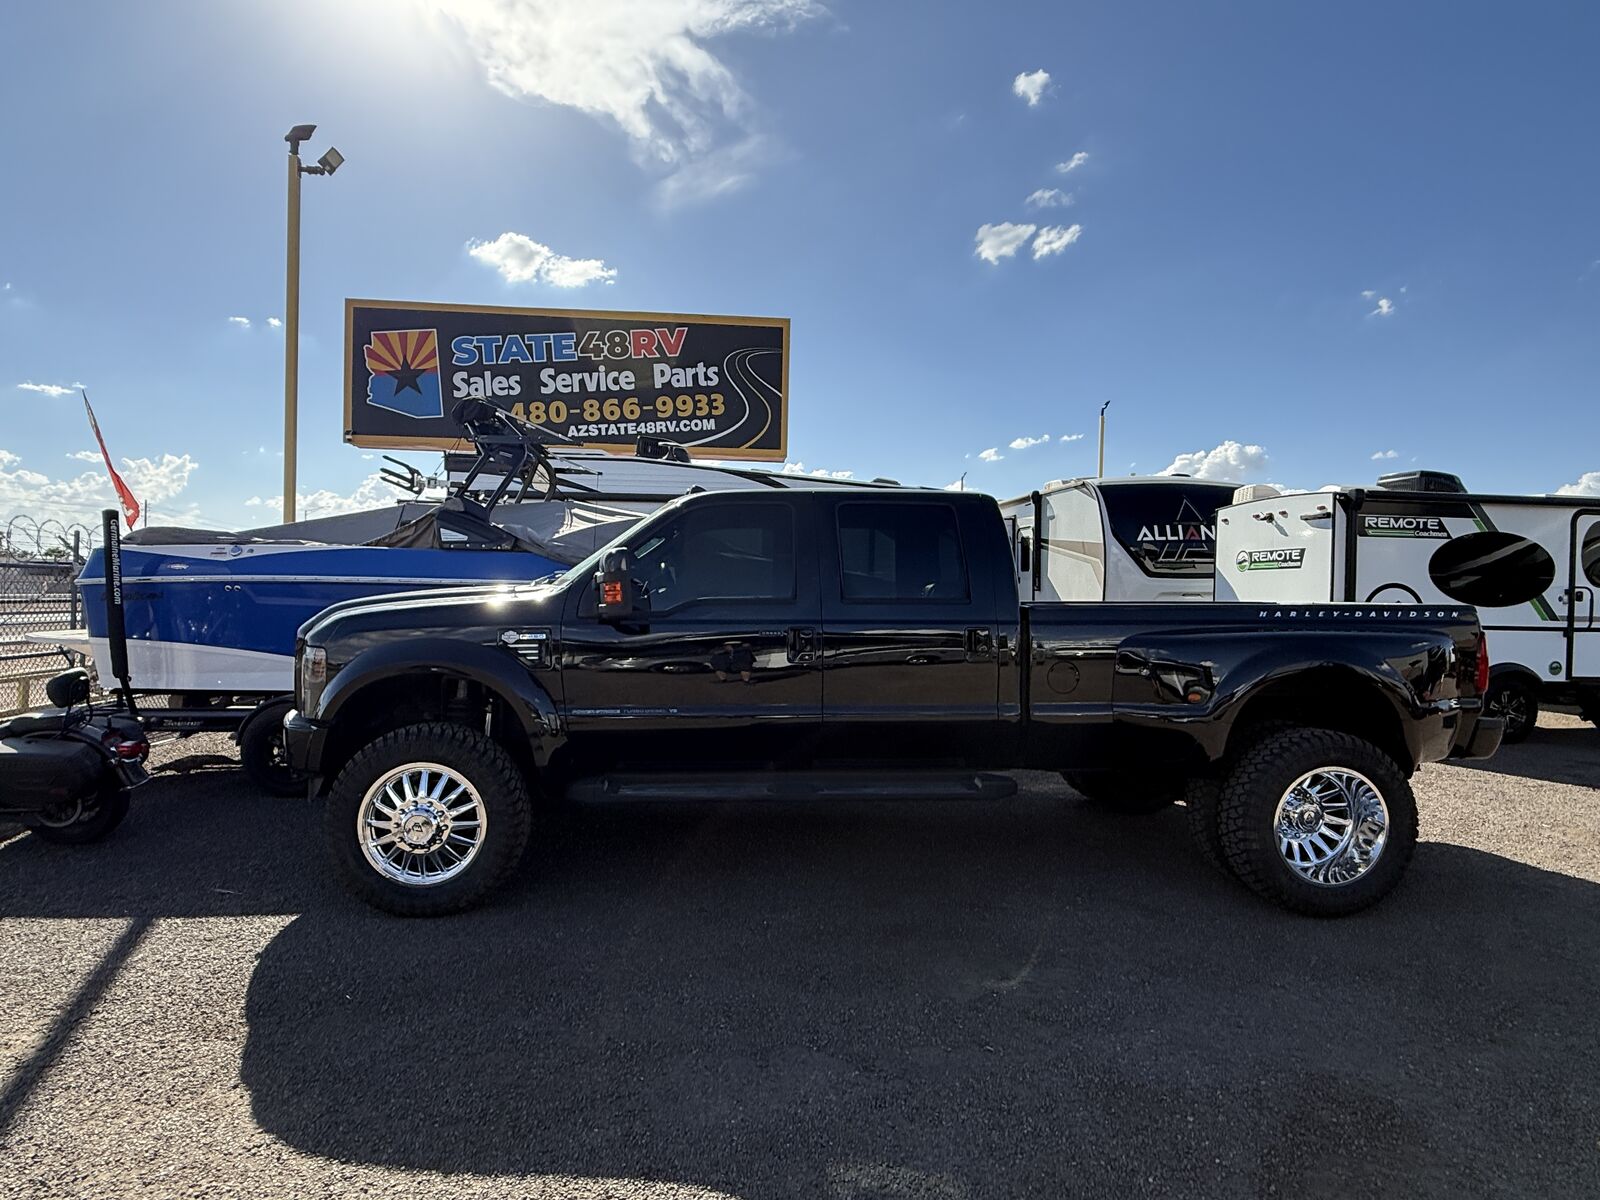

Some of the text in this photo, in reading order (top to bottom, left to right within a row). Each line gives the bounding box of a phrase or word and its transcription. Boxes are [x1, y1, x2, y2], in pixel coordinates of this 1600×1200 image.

[451, 327, 688, 366] STATE48RV
[452, 362, 719, 398] Sales Service Parts
[511, 393, 726, 425] 480-866-9933
[567, 418, 716, 438] AZSTATE48RV.COM
[1365, 517, 1439, 529] REMOTE
[110, 518, 121, 605] GermaineMarine.com
[1251, 550, 1301, 562] REMOTE
